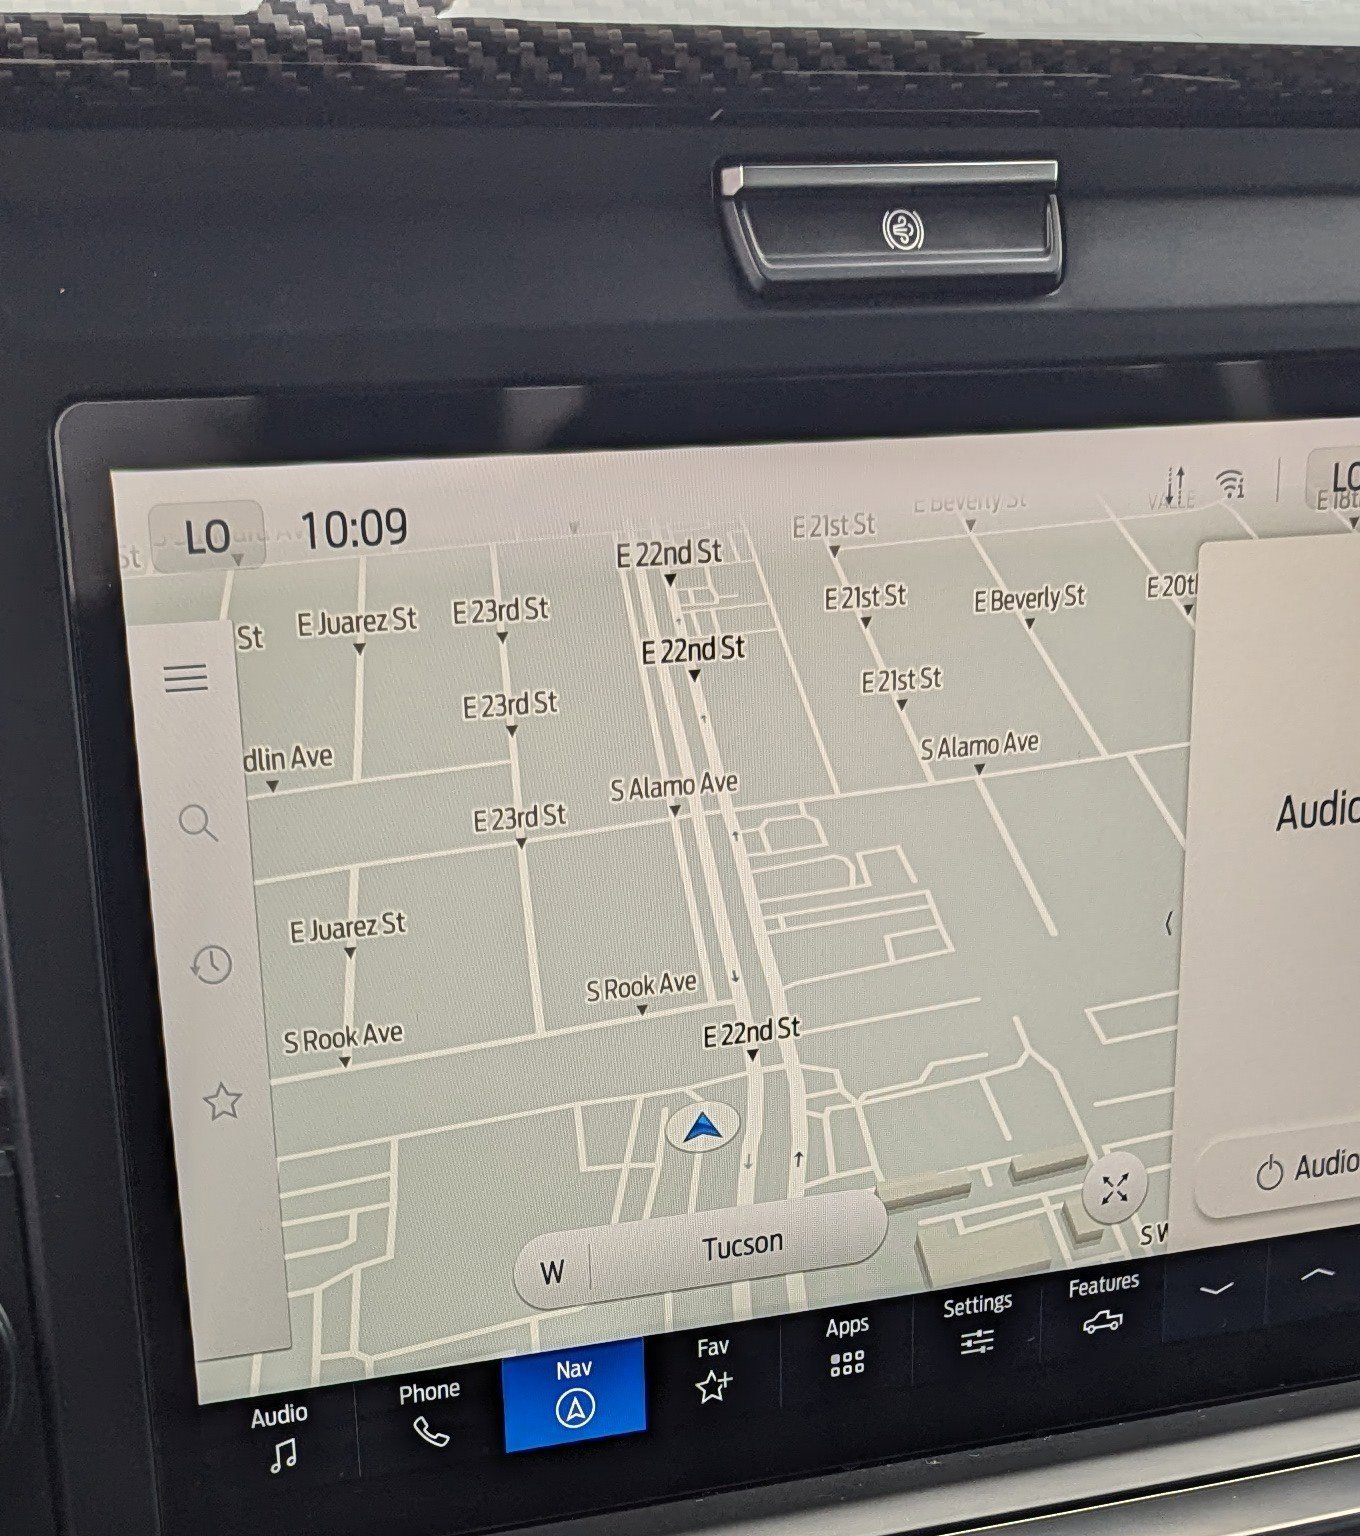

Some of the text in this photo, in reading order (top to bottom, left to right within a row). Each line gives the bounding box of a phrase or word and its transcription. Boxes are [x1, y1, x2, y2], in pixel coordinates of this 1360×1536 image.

[1317, 490, 1327, 511] E
[186, 519, 230, 555] LO
[302, 507, 408, 550] 10:09
[793, 513, 875, 538] E 21st St
[617, 539, 722, 568] E 22nd St
[826, 584, 906, 610] E 21st St
[975, 585, 1085, 612] E Beverly St
[1148, 576, 1159, 598] E
[298, 606, 417, 636] E Juarez St
[454, 597, 549, 624] E 23rd St
[238, 625, 263, 649] St
[643, 635, 745, 664] E 22nd St
[863, 667, 941, 693] E 21st St
[464, 691, 557, 718] E 23rd St
[291, 746, 333, 769] Ave
[921, 731, 1039, 760] S Alamo Ave
[611, 772, 738, 801] S Alamo Ave
[474, 804, 566, 832] E 23rd St
[291, 912, 406, 943] E Juarez St
[587, 972, 697, 1001] S Rook Ave
[284, 1022, 403, 1053] S Rook Ave
[703, 1017, 801, 1048] E 22nd St
[1295, 1148, 1360, 1180] Audio
[702, 1230, 783, 1262] Tucson
[1141, 1225, 1152, 1245] S
[540, 1260, 565, 1286] W
[1069, 1271, 1140, 1299] Features
[943, 1292, 1013, 1320] Settings
[826, 1315, 870, 1340] Apps
[697, 1338, 730, 1358] Fav
[556, 1359, 592, 1380] Nav
[399, 1380, 461, 1405] Phone
[251, 1402, 309, 1428] Audio
